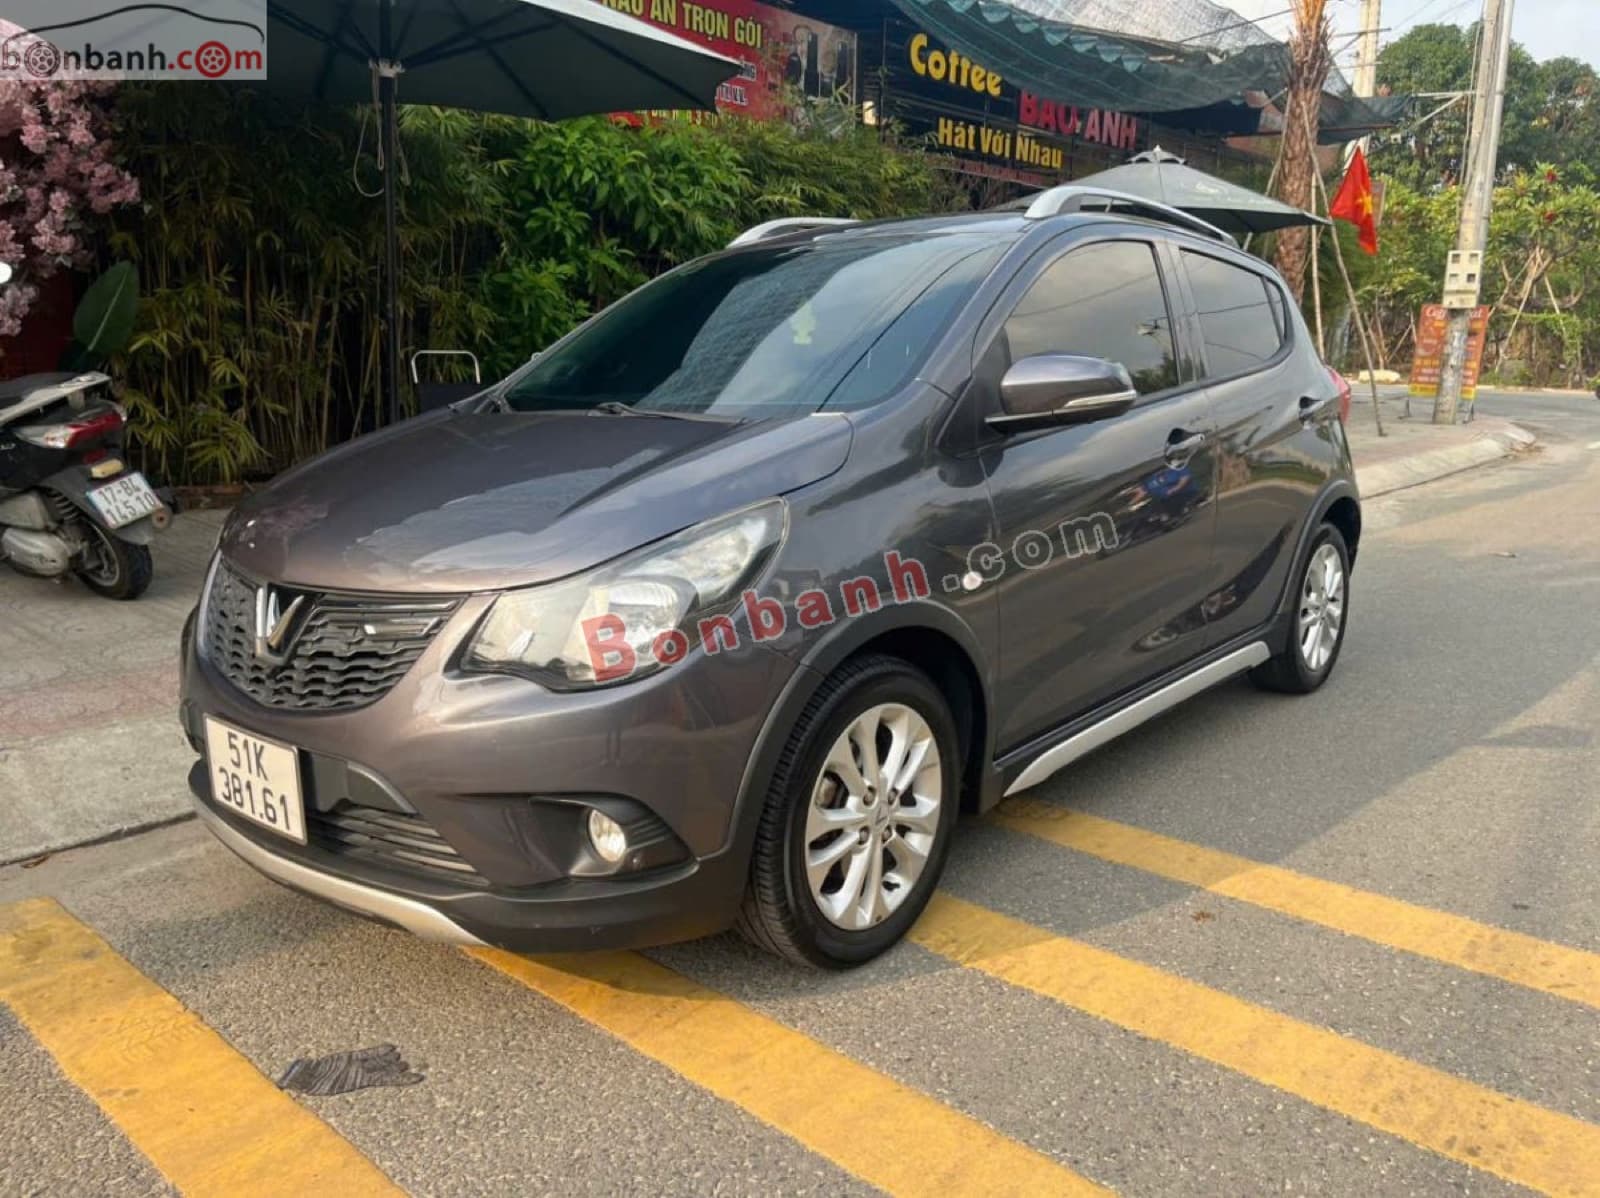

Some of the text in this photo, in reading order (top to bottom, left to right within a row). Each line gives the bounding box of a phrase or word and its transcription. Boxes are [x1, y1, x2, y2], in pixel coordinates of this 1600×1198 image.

[682, 3, 729, 41] TRỌN
[734, 16, 762, 48] GÓI
[909, 32, 1003, 97] Coffee
[938, 117, 1065, 169] Hát Với Nhau
[227, 730, 269, 782] 51K
[218, 766, 291, 831] 381.61
